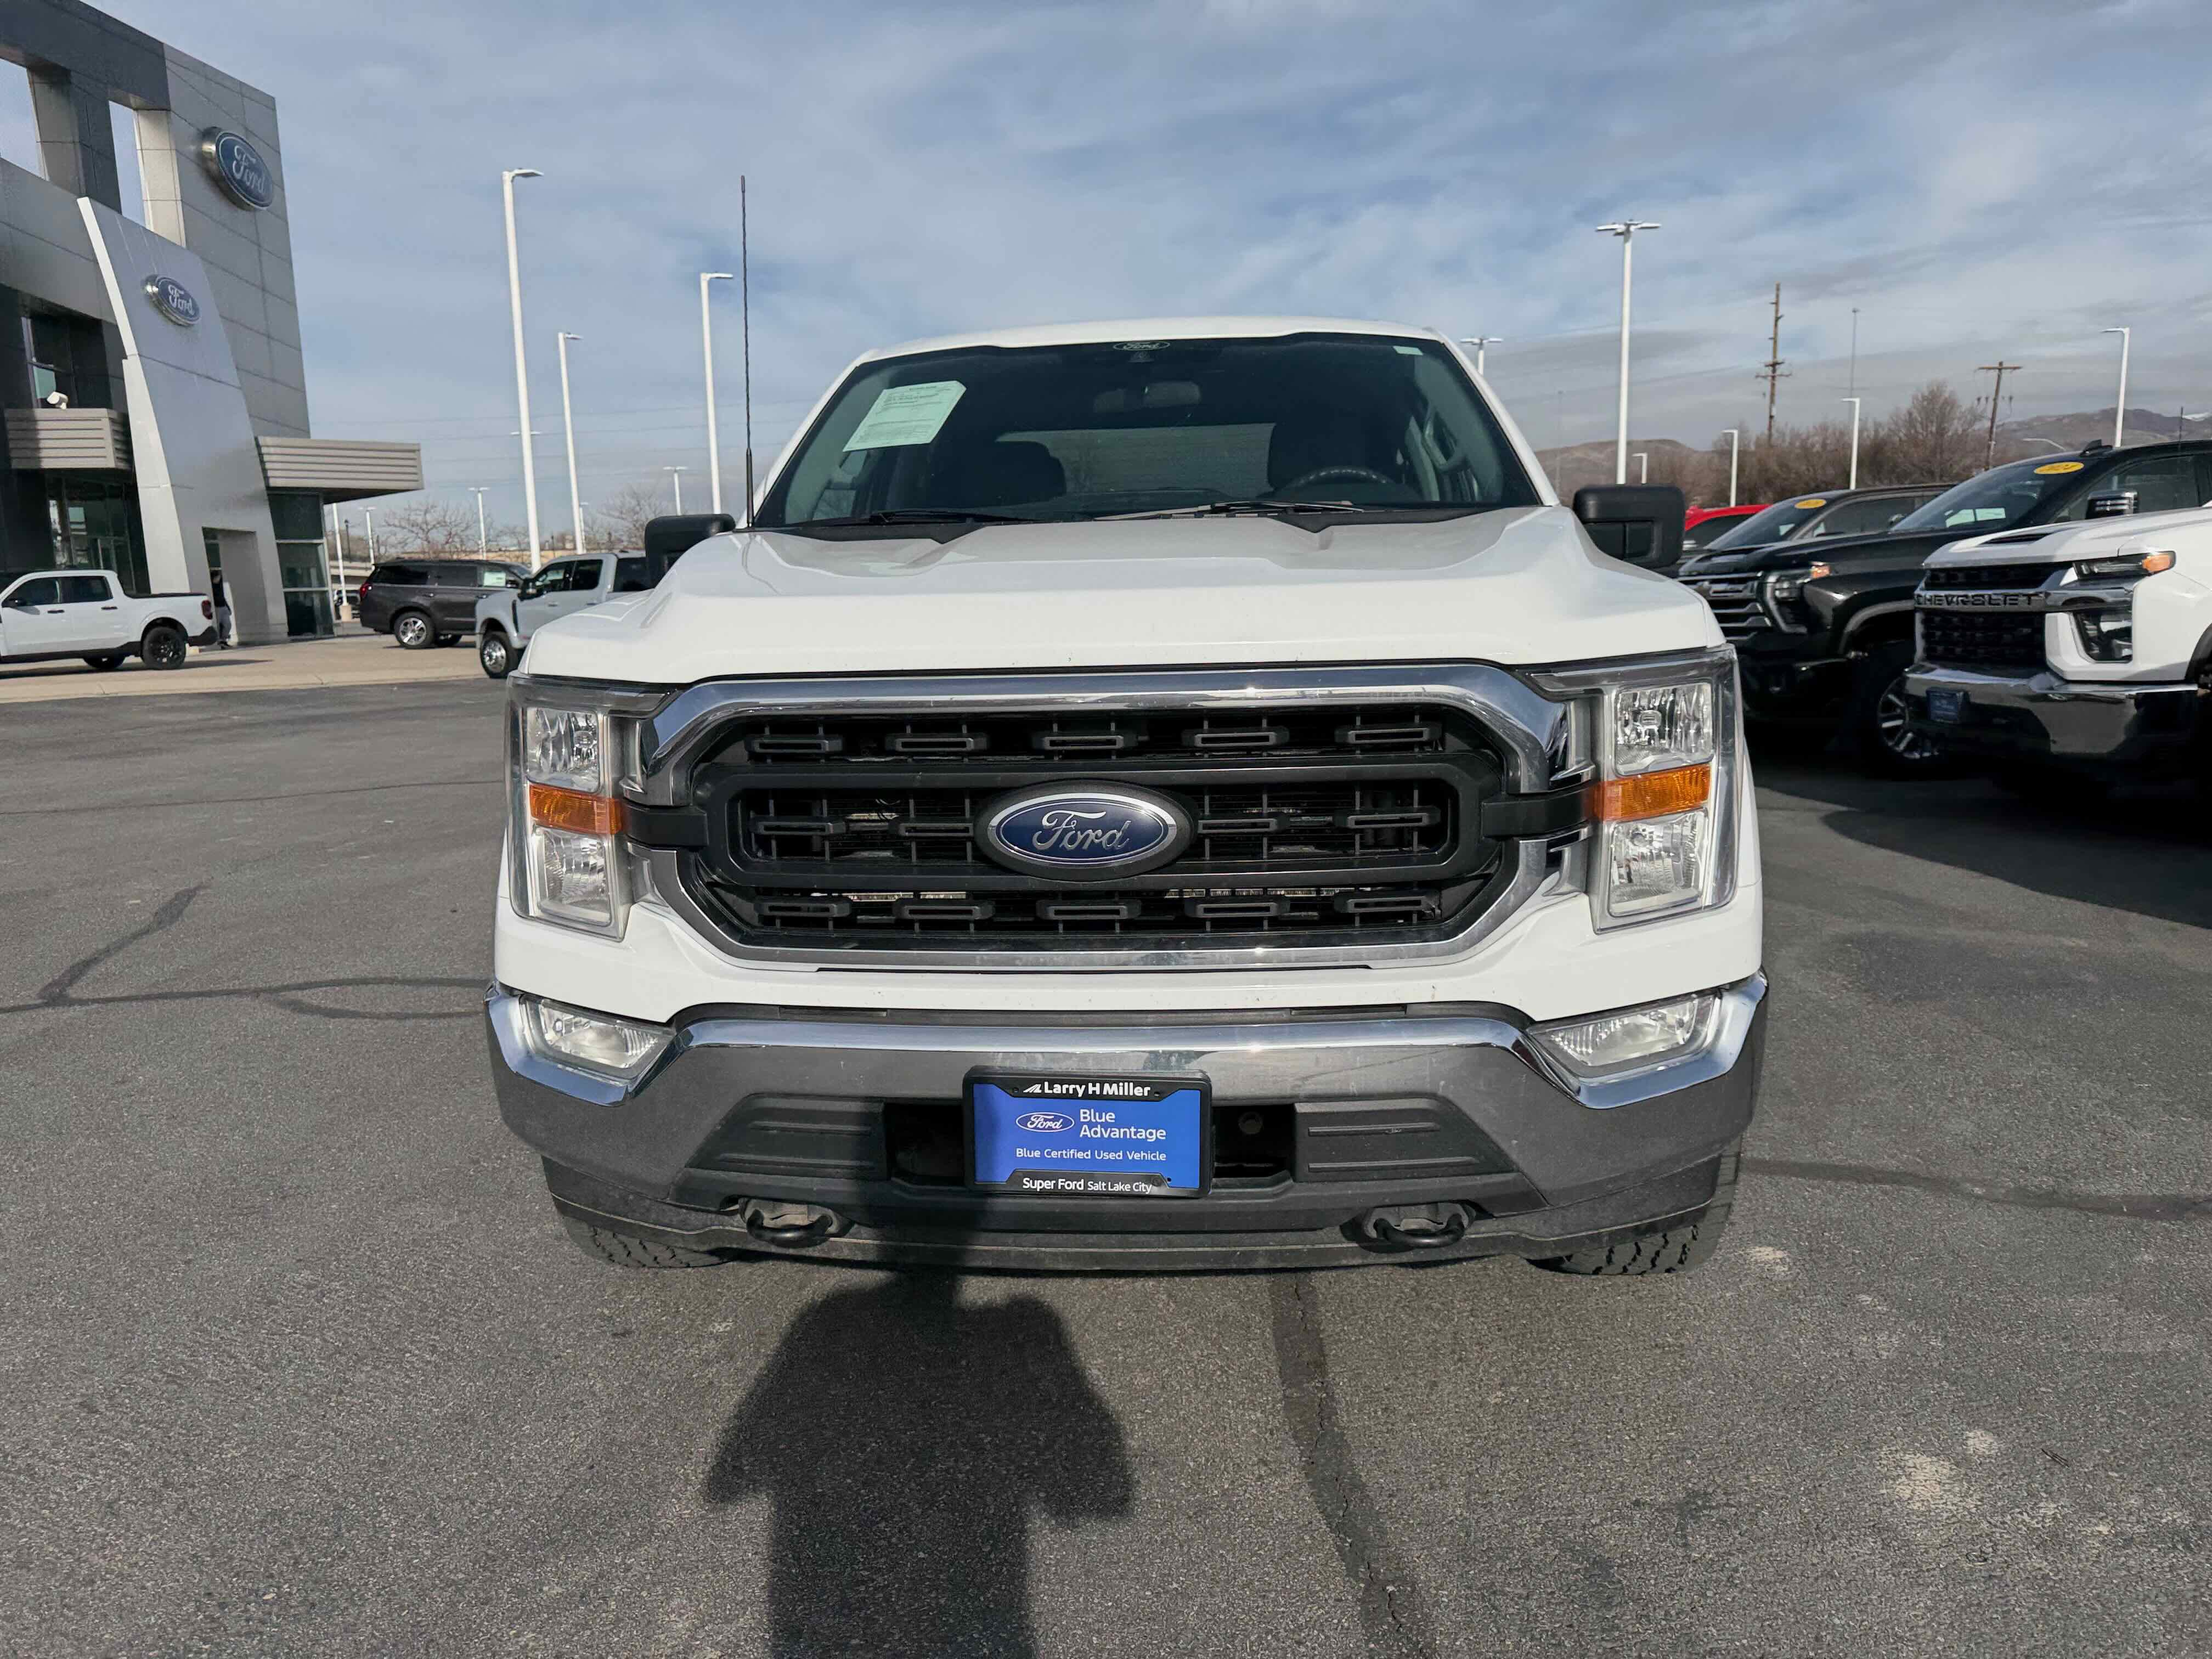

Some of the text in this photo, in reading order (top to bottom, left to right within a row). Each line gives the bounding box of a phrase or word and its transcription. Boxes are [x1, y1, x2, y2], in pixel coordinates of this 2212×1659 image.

[232, 145, 266, 194] Ford
[168, 284, 195, 316] Ford
[1914, 593, 2044, 606] CHEVROLET
[1032, 809, 1132, 851] Ford
[1044, 1081, 1151, 1097] Larry H Miller
[1027, 1114, 1063, 1130] Ford
[1080, 1109, 1115, 1122] Blue
[1080, 1124, 1166, 1142] Advantage
[1016, 1148, 1166, 1161] Blue Certified Used Vehicle
[1023, 1177, 1152, 1194] Super Ford Salt Lake City
